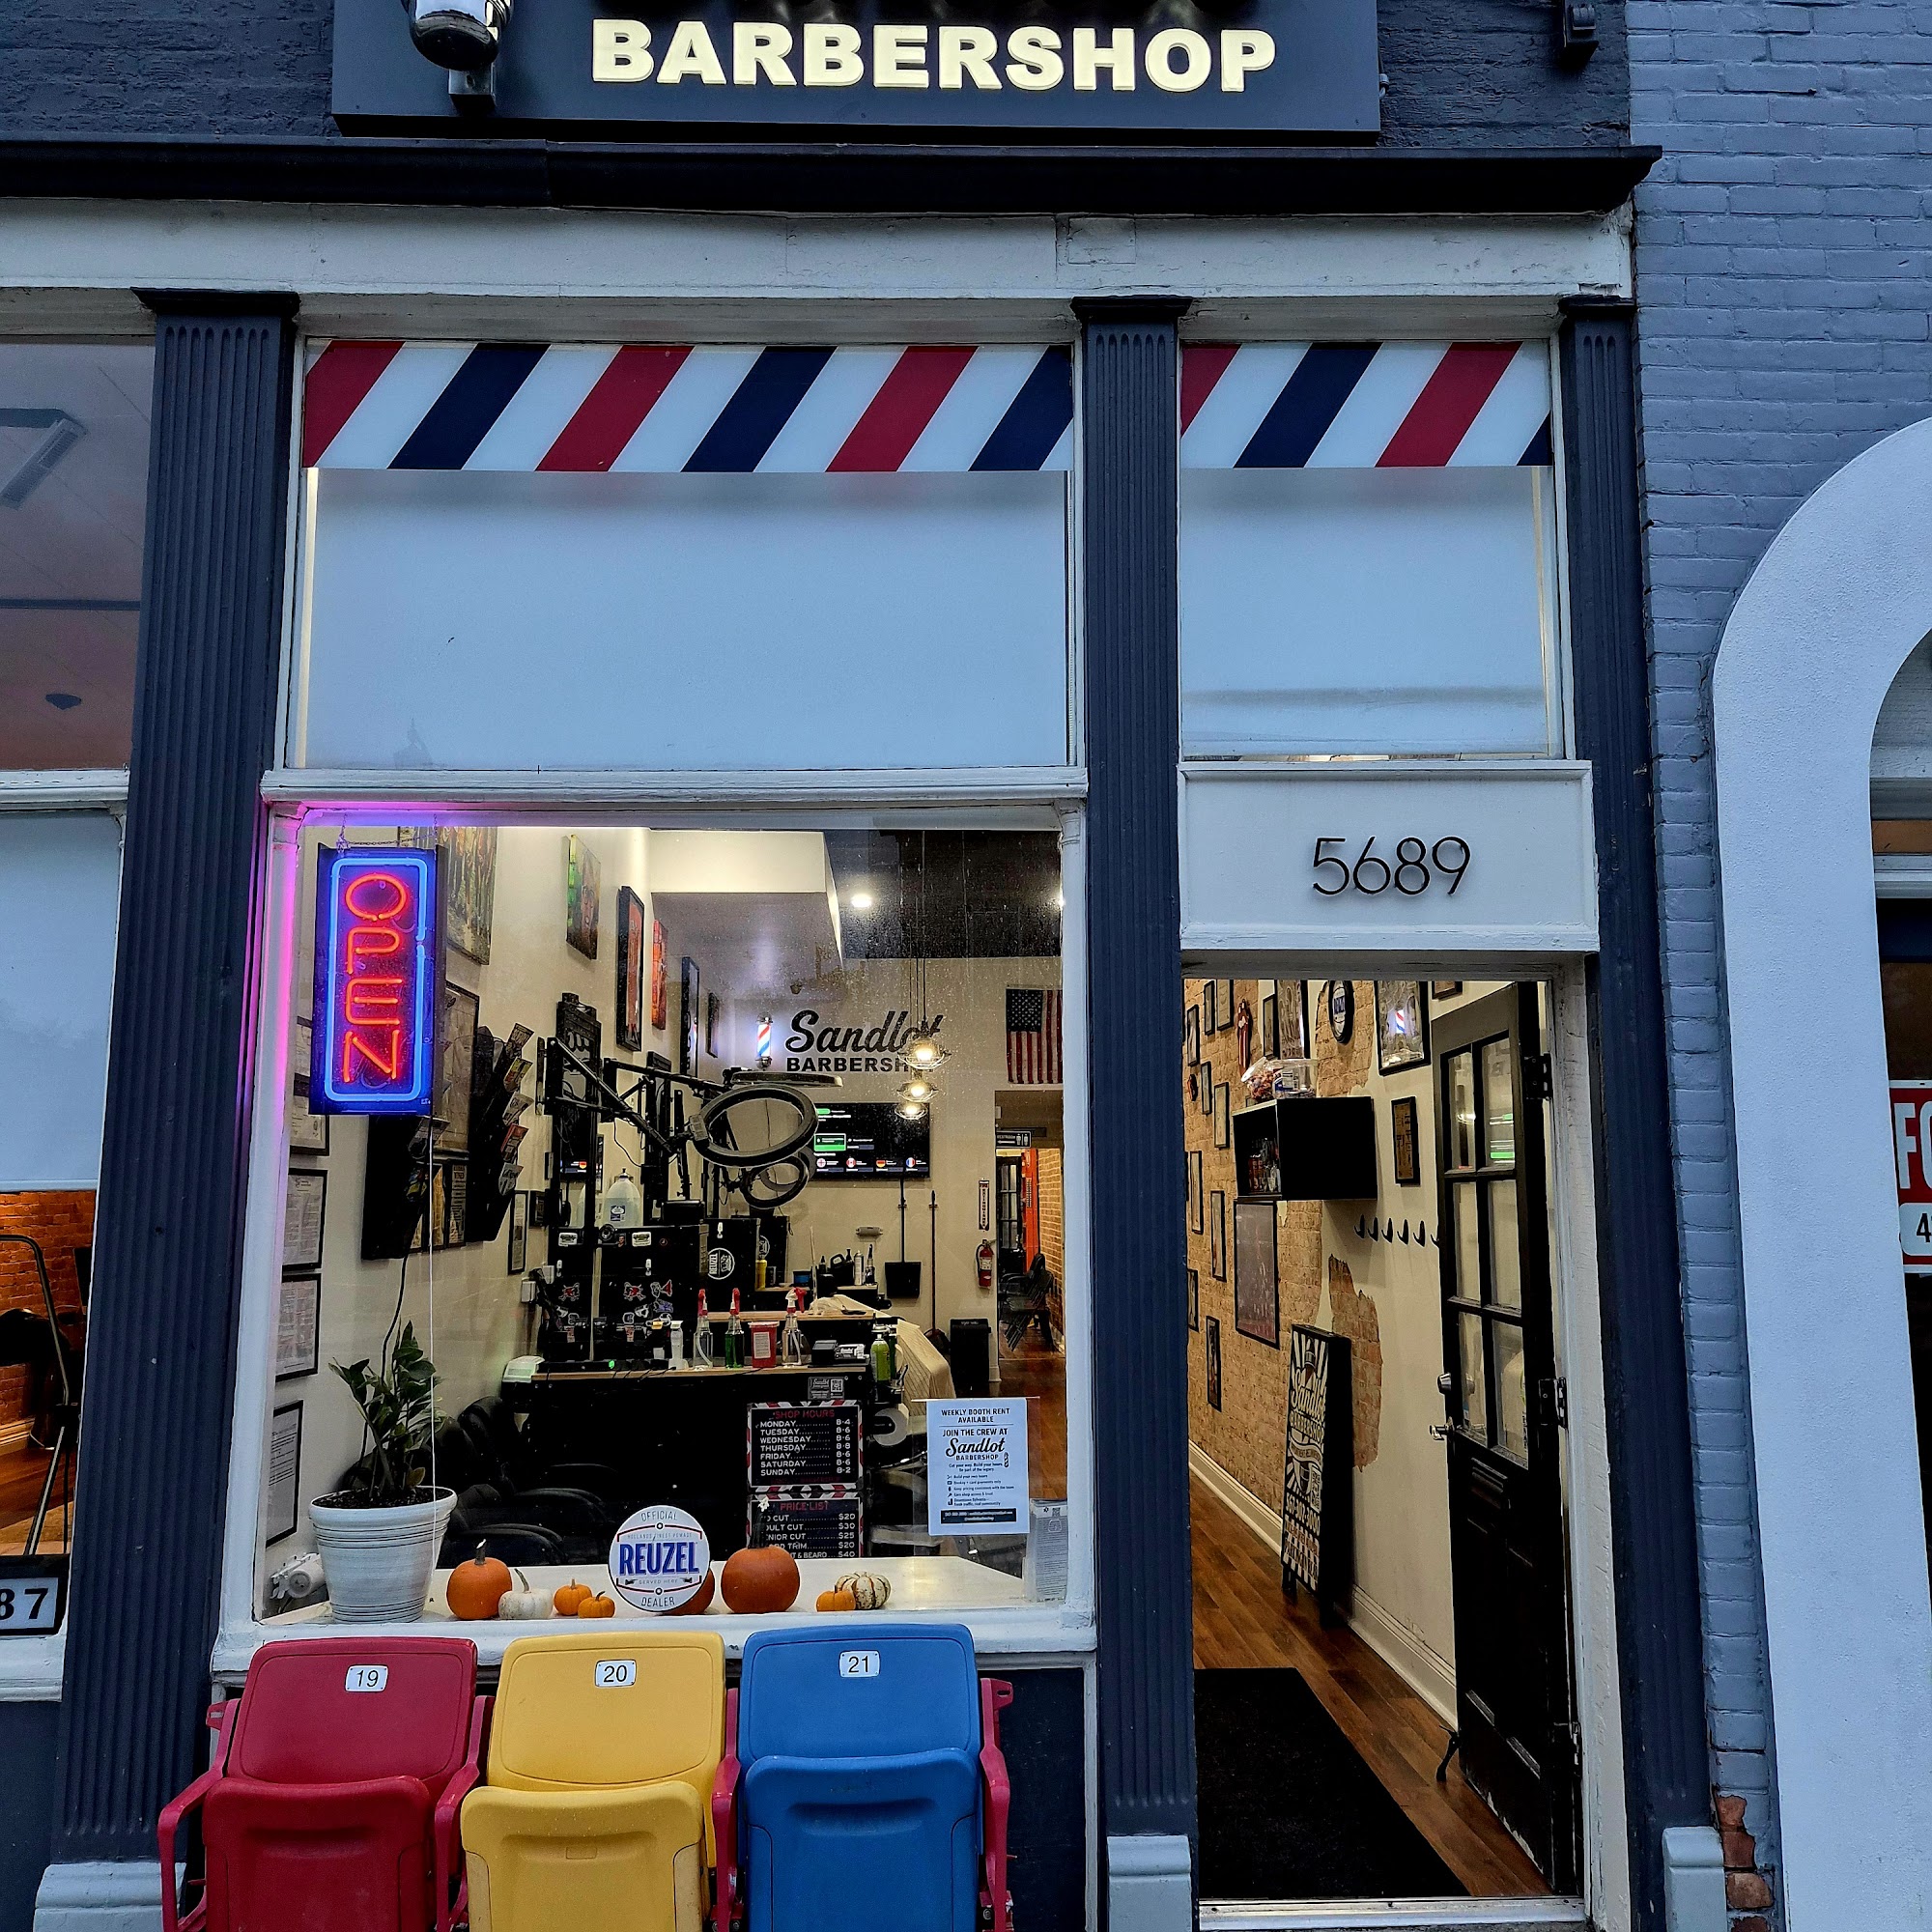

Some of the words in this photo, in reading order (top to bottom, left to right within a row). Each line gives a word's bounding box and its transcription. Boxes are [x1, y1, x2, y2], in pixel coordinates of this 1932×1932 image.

[592, 18, 1276, 93] BARBERSHOP
[1313, 836, 1471, 895] 5689
[343, 872, 409, 1083] OPEN
[786, 1058, 933, 1072] BARBERSH
[775, 1411, 800, 1419] SHOP
[803, 1410, 835, 1418] HOURS
[945, 1437, 1005, 1457] Sandlot
[780, 1502, 806, 1511] PRICE
[809, 1501, 829, 1510] LIST
[641, 1510, 677, 1522] OFFICIAL
[619, 1542, 699, 1576] REUZEL
[0, 1588, 48, 1620] 87
[641, 1596, 675, 1607] DEALER
[848, 1655, 867, 1672] 21
[356, 1669, 379, 1688] 19
[604, 1665, 627, 1682] 20
